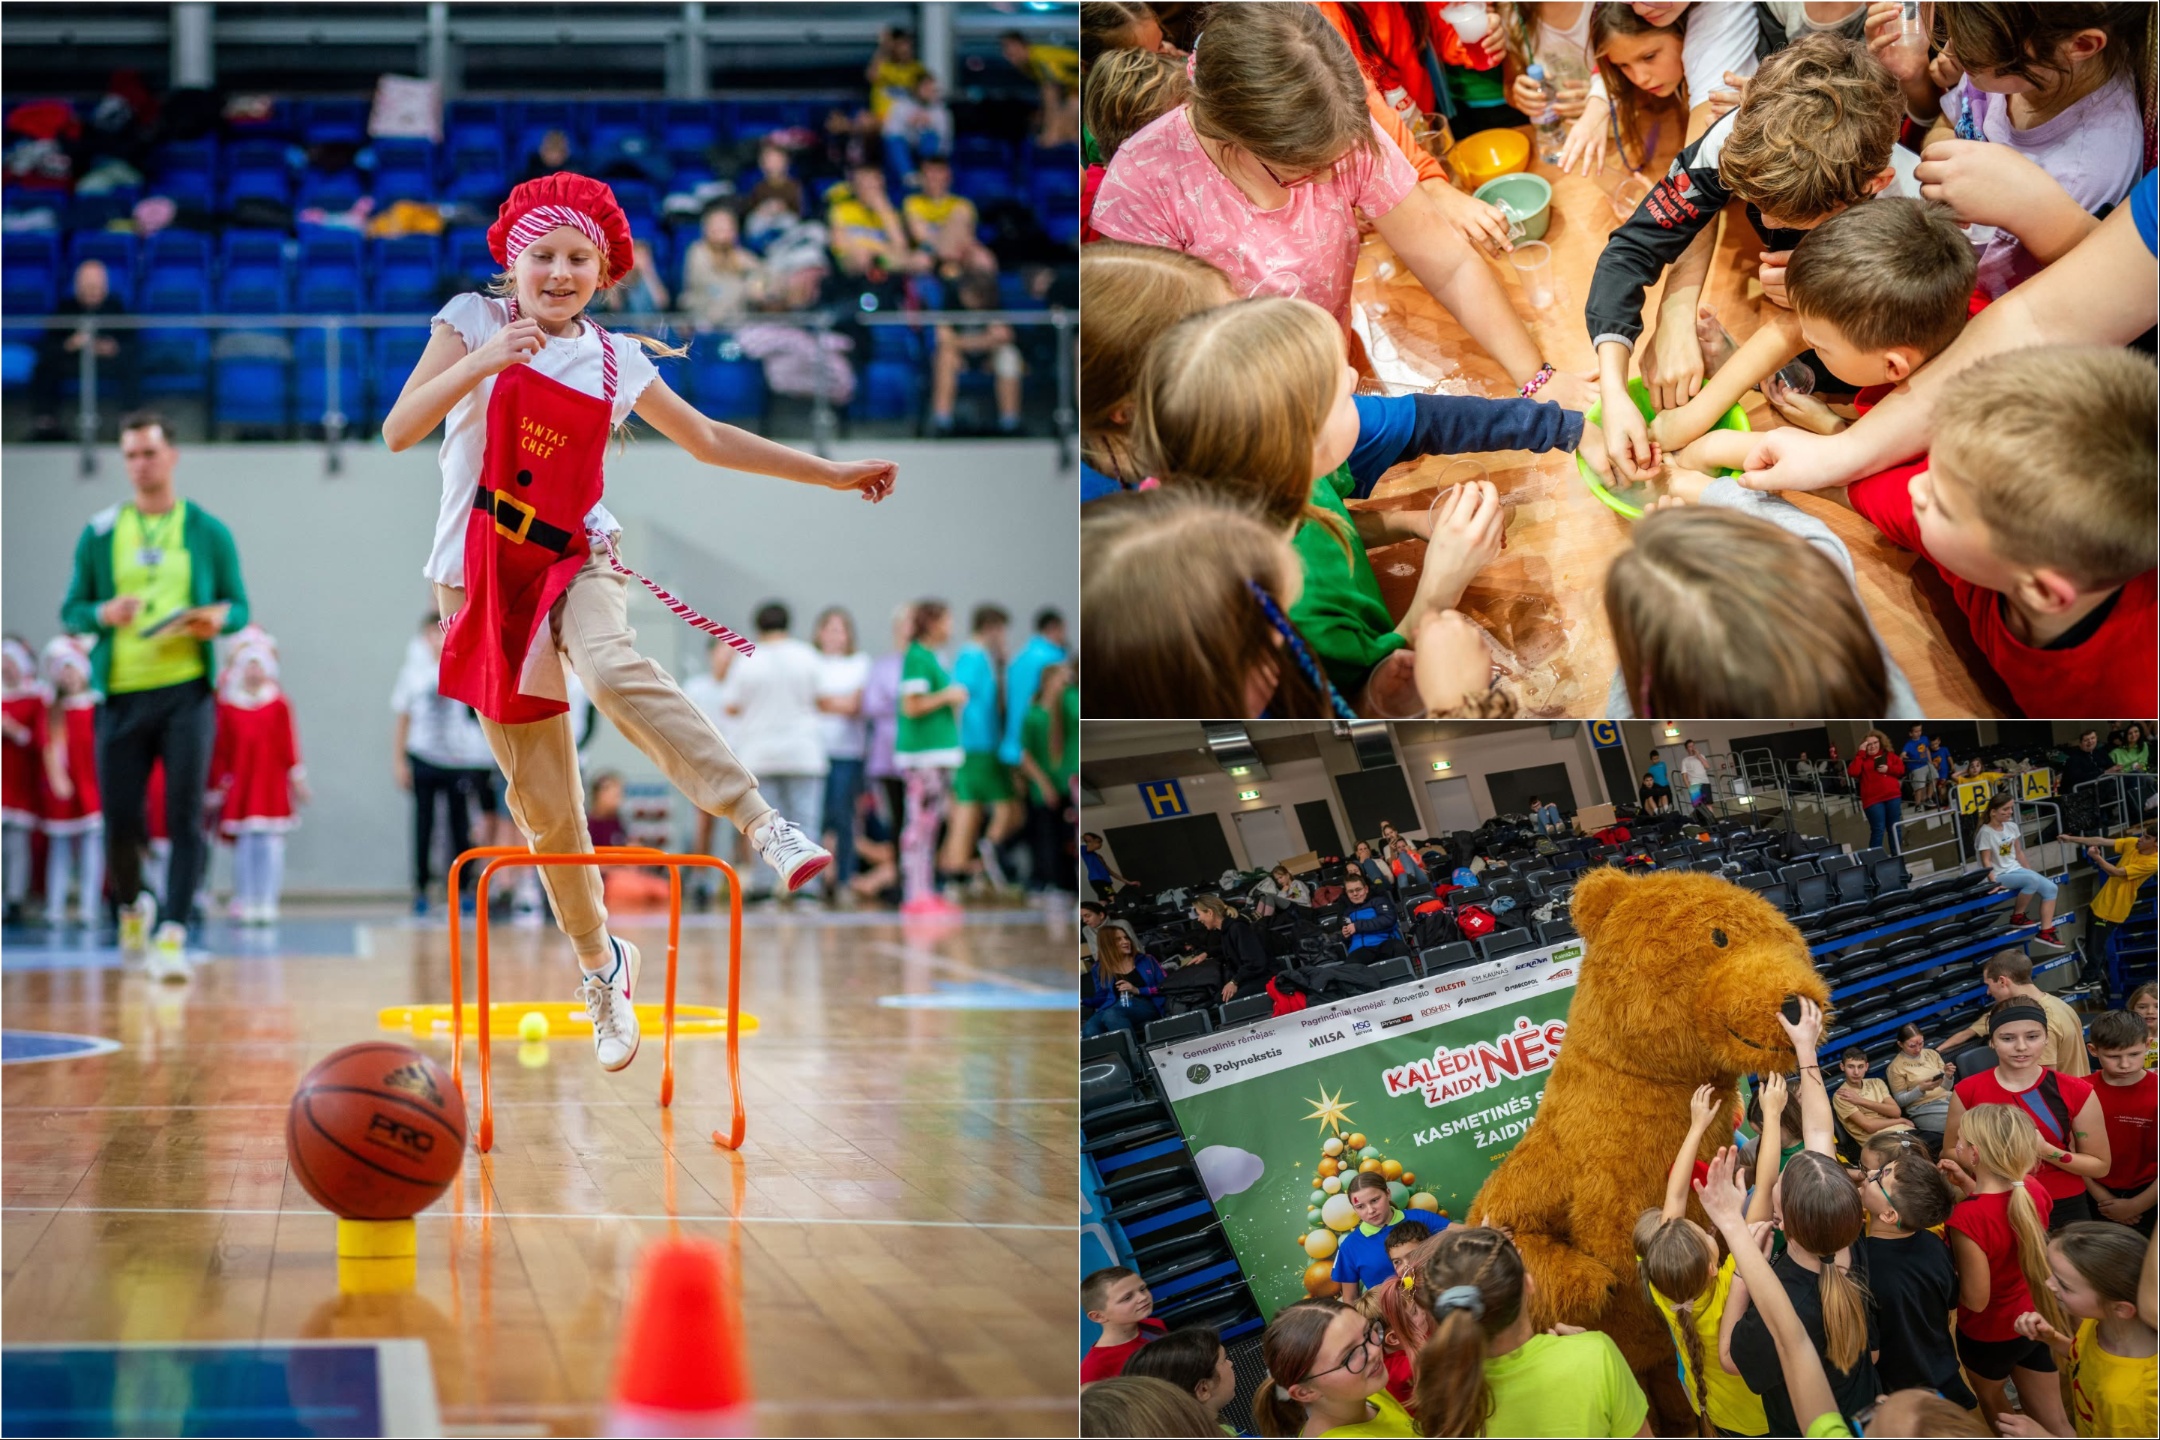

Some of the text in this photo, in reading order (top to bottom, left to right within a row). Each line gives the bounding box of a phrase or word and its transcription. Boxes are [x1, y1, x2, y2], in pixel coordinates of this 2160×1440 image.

[1645, 198, 1673, 229] VARCO
[521, 416, 568, 447] SANTAS
[521, 436, 554, 459] CHEF
[1593, 720, 1616, 744] G
[1972, 785, 1987, 808] B
[2027, 775, 2039, 795] A
[1146, 783, 1182, 815] H
[1471, 973, 1482, 983] CM
[1483, 967, 1509, 980] KAUNAS
[1434, 980, 1466, 994] GILESTA
[1463, 990, 1497, 1004] straumann
[1301, 999, 1387, 1028] Pagrindiniai rėmėjai:
[1420, 1002, 1451, 1017] ROSHEN
[1352, 1020, 1371, 1032] HSG
[1183, 1029, 1276, 1060] Generalinis rėmėjas:
[1309, 1030, 1345, 1048] MILSA
[1213, 1048, 1282, 1074] Polynekstis
[1426, 1073, 1482, 1104] ŽAIDY
[369, 1112, 435, 1153] PRO
[1413, 1096, 1532, 1147] KASMETINĖS
[1490, 1152, 1506, 1162] 2024
